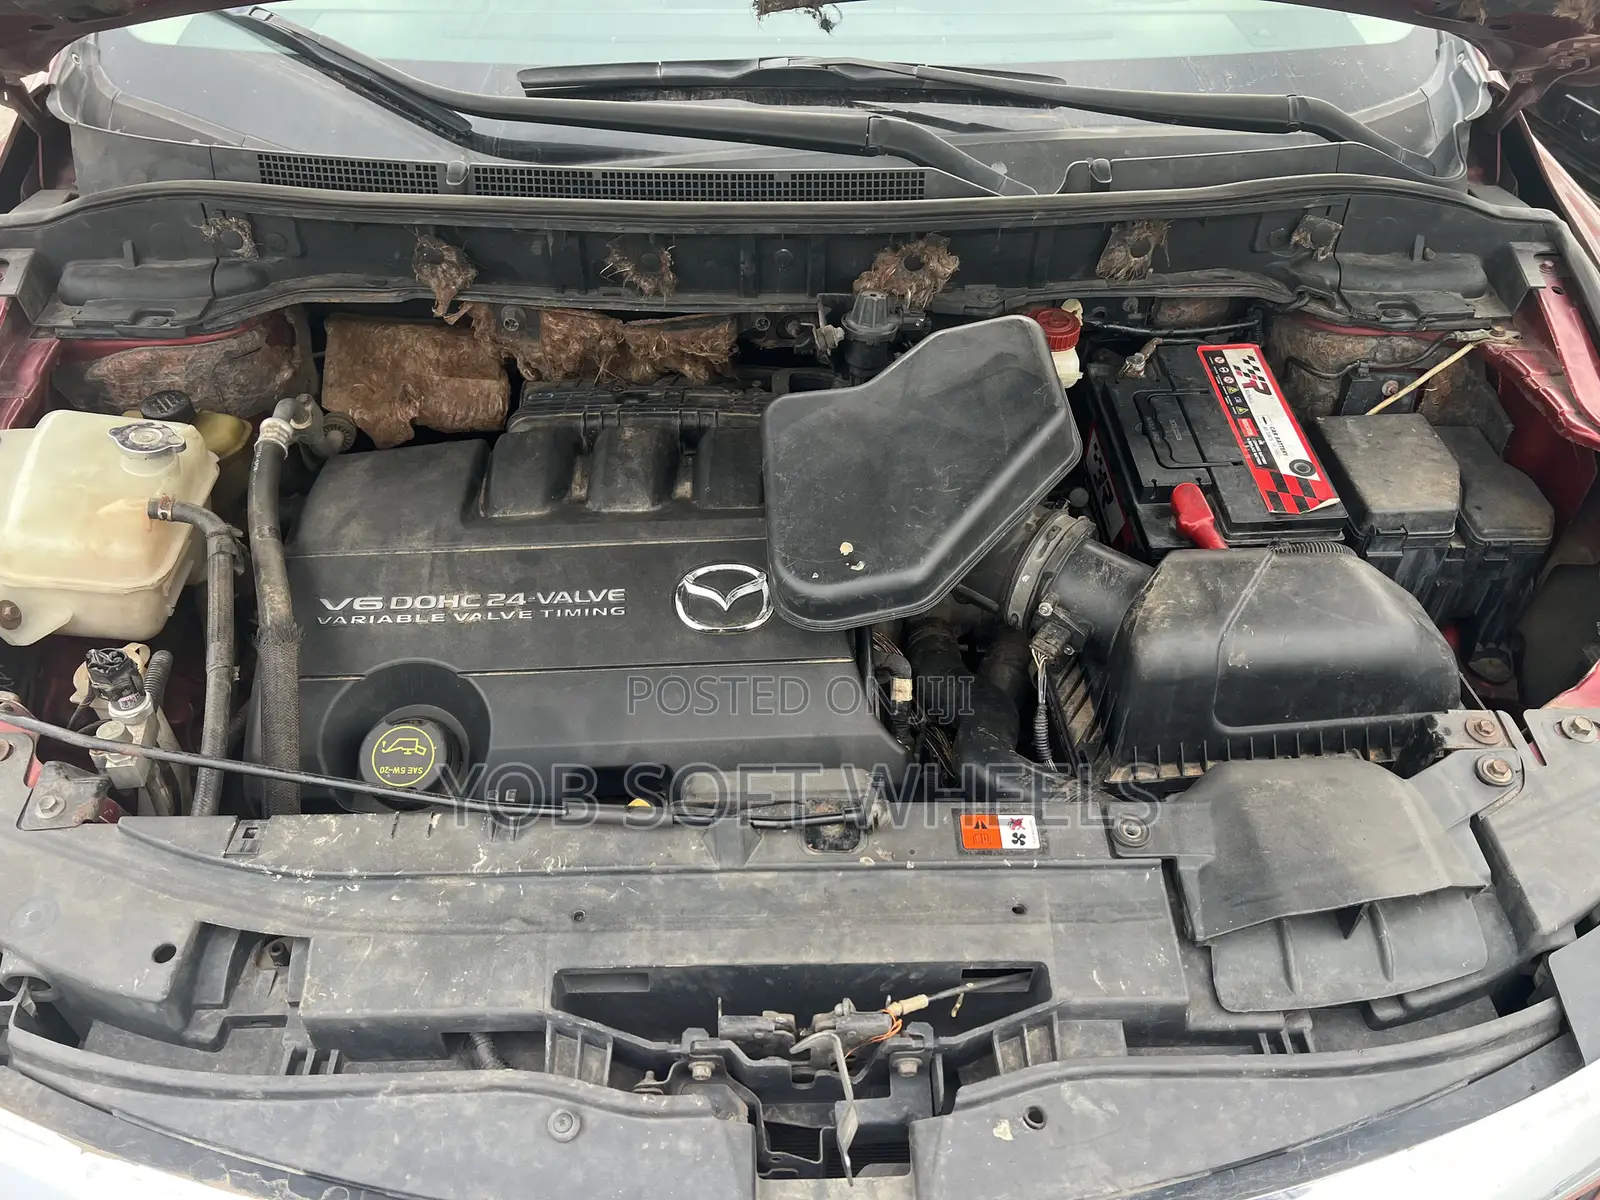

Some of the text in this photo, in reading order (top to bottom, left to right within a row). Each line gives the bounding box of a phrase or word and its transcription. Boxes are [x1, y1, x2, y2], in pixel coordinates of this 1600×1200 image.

[318, 588, 627, 612] V6 DOHC 24-VALVE
[316, 606, 626, 625] VARIABLE VALVE TIMING
[379, 766, 423, 775] SAE 5W-20
